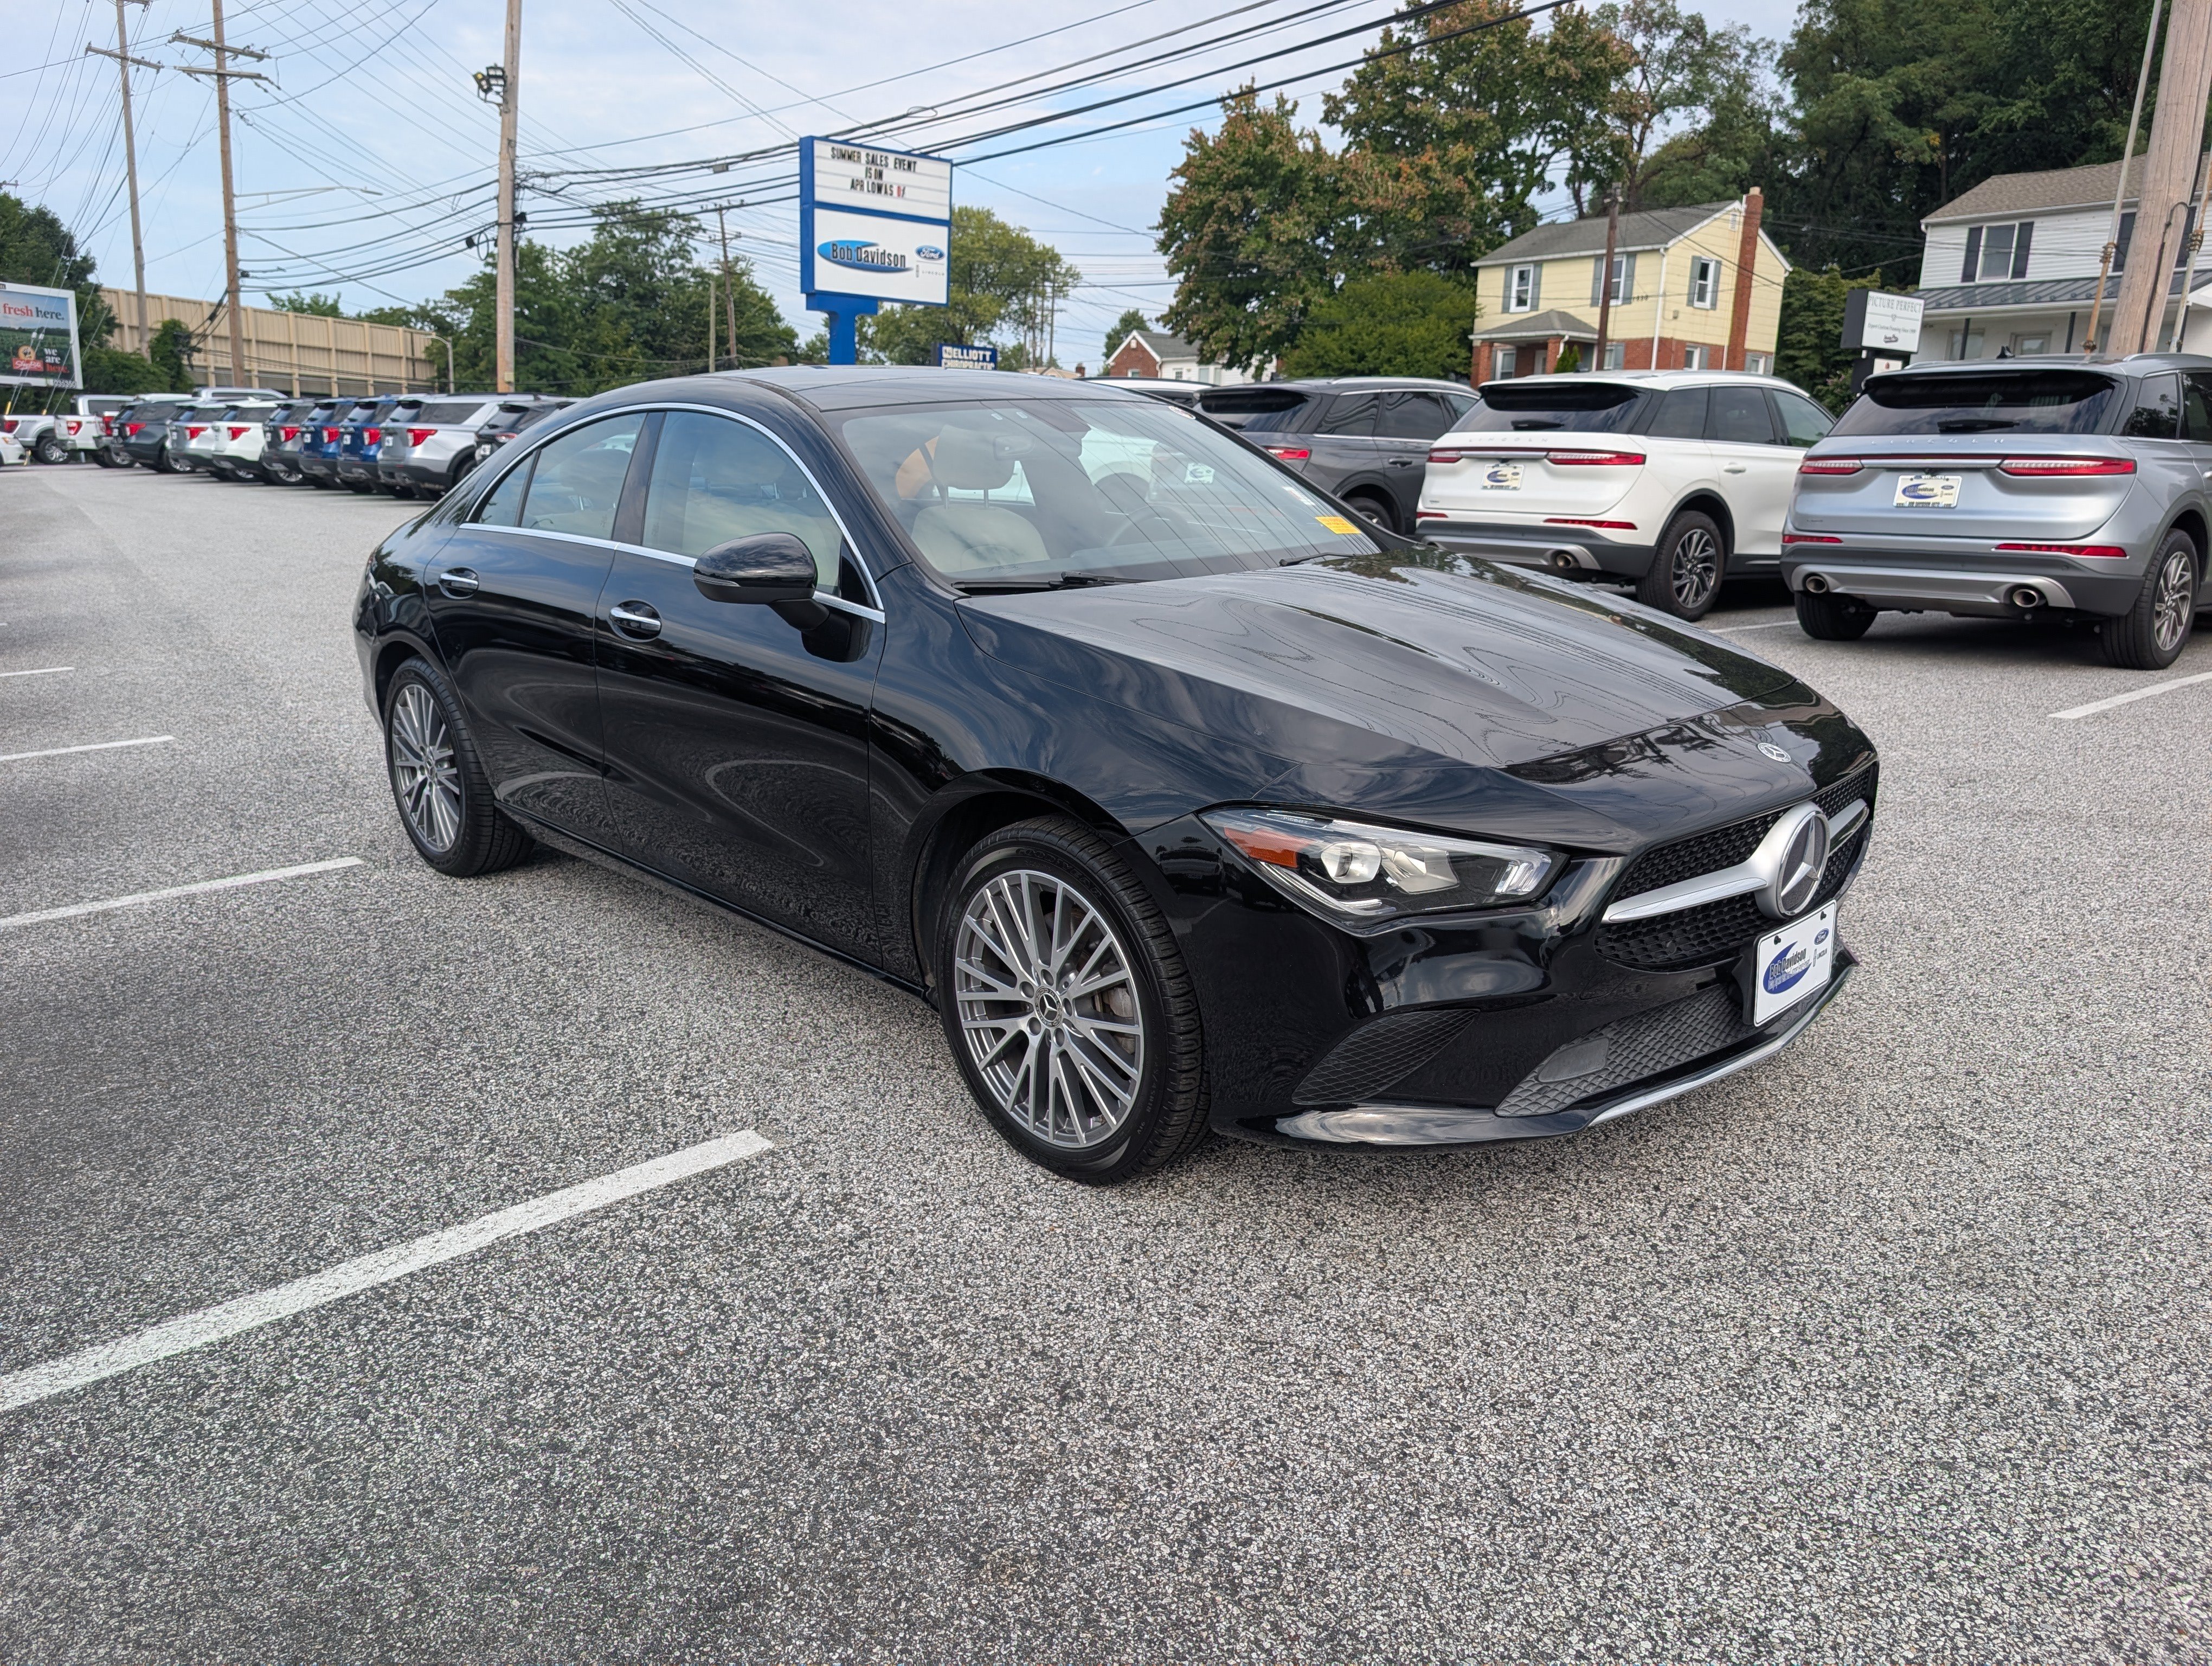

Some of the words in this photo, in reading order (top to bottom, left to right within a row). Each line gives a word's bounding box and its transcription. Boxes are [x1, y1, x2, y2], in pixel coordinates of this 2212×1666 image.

[831, 146, 861, 163] SUMMER
[865, 152, 889, 168] SALES
[893, 157, 917, 172] EVENT
[865, 166, 872, 179] IS
[850, 177, 864, 191] APR
[832, 242, 852, 261] Bob
[856, 246, 906, 268] Davidson
[3, 303, 34, 317] fresh
[35, 306, 65, 321] here.
[1868, 296, 1895, 310] PICTURE
[1896, 299, 1922, 314] PERFECT
[43, 348, 58, 356] we
[44, 355, 61, 364] are
[953, 347, 992, 362] ELLIOTT
[1015, 847, 1103, 899] GOODYEAR
[1769, 959, 1782, 978] Bob
[1782, 947, 1807, 973] Davidson
